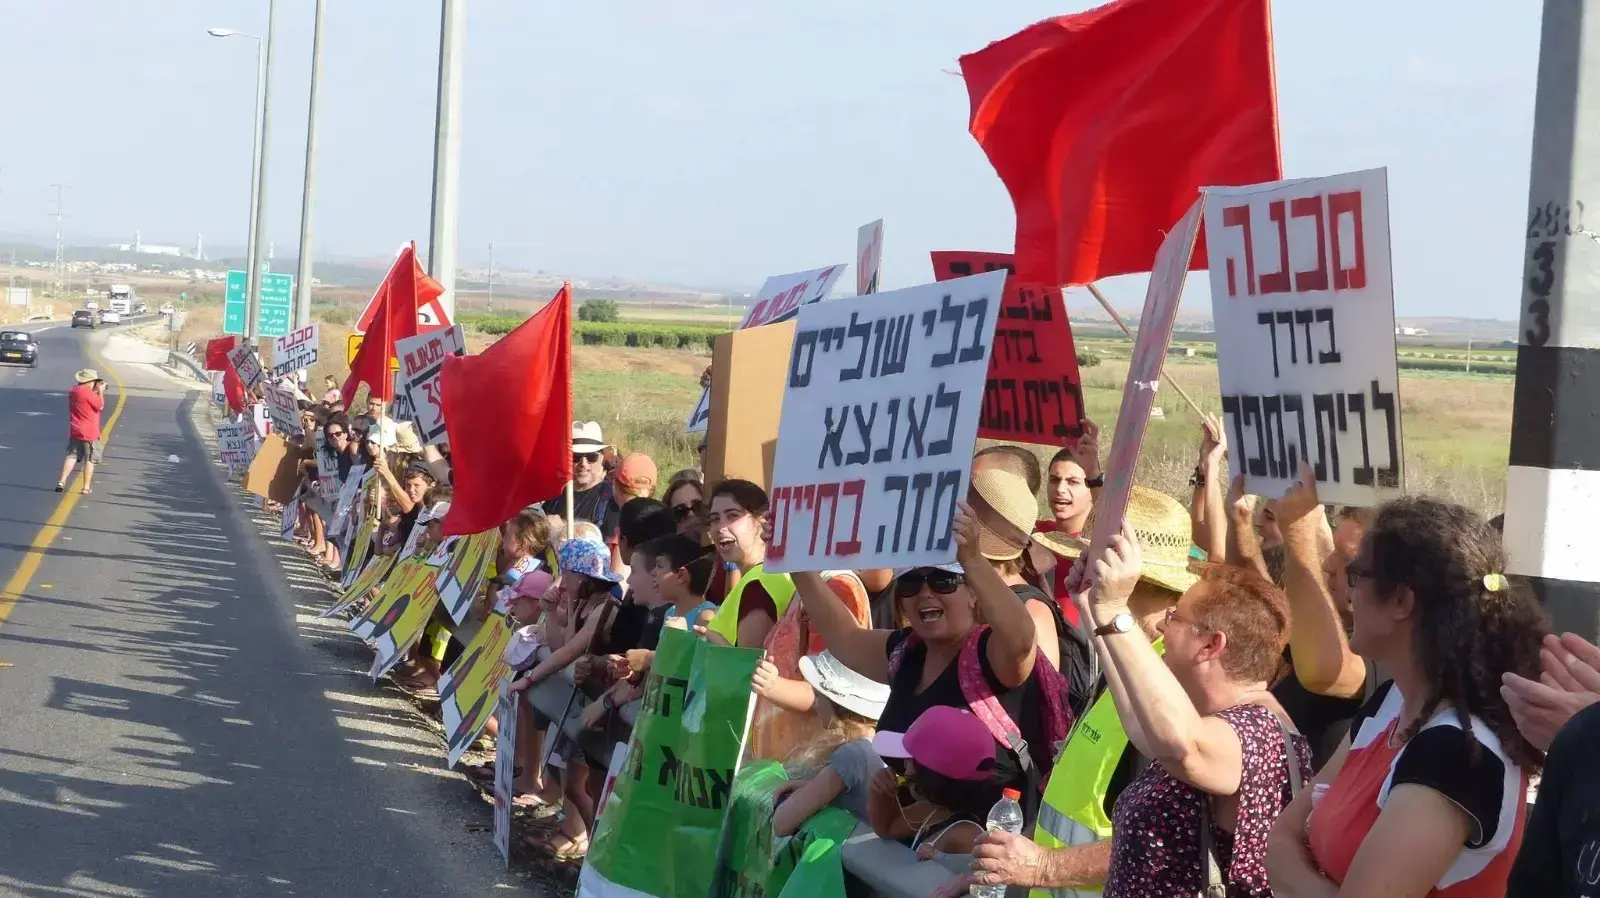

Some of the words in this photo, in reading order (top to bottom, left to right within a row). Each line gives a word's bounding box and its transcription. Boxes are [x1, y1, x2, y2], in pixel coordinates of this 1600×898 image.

[1222, 191, 1367, 297] סכנה
[789, 310, 914, 388] שוליים
[922, 295, 988, 368] בלי
[1257, 308, 1341, 377] בדרך
[1314, 380, 1398, 487] לבית
[766, 479, 866, 561] בחיים
[875, 470, 961, 553] מזה
